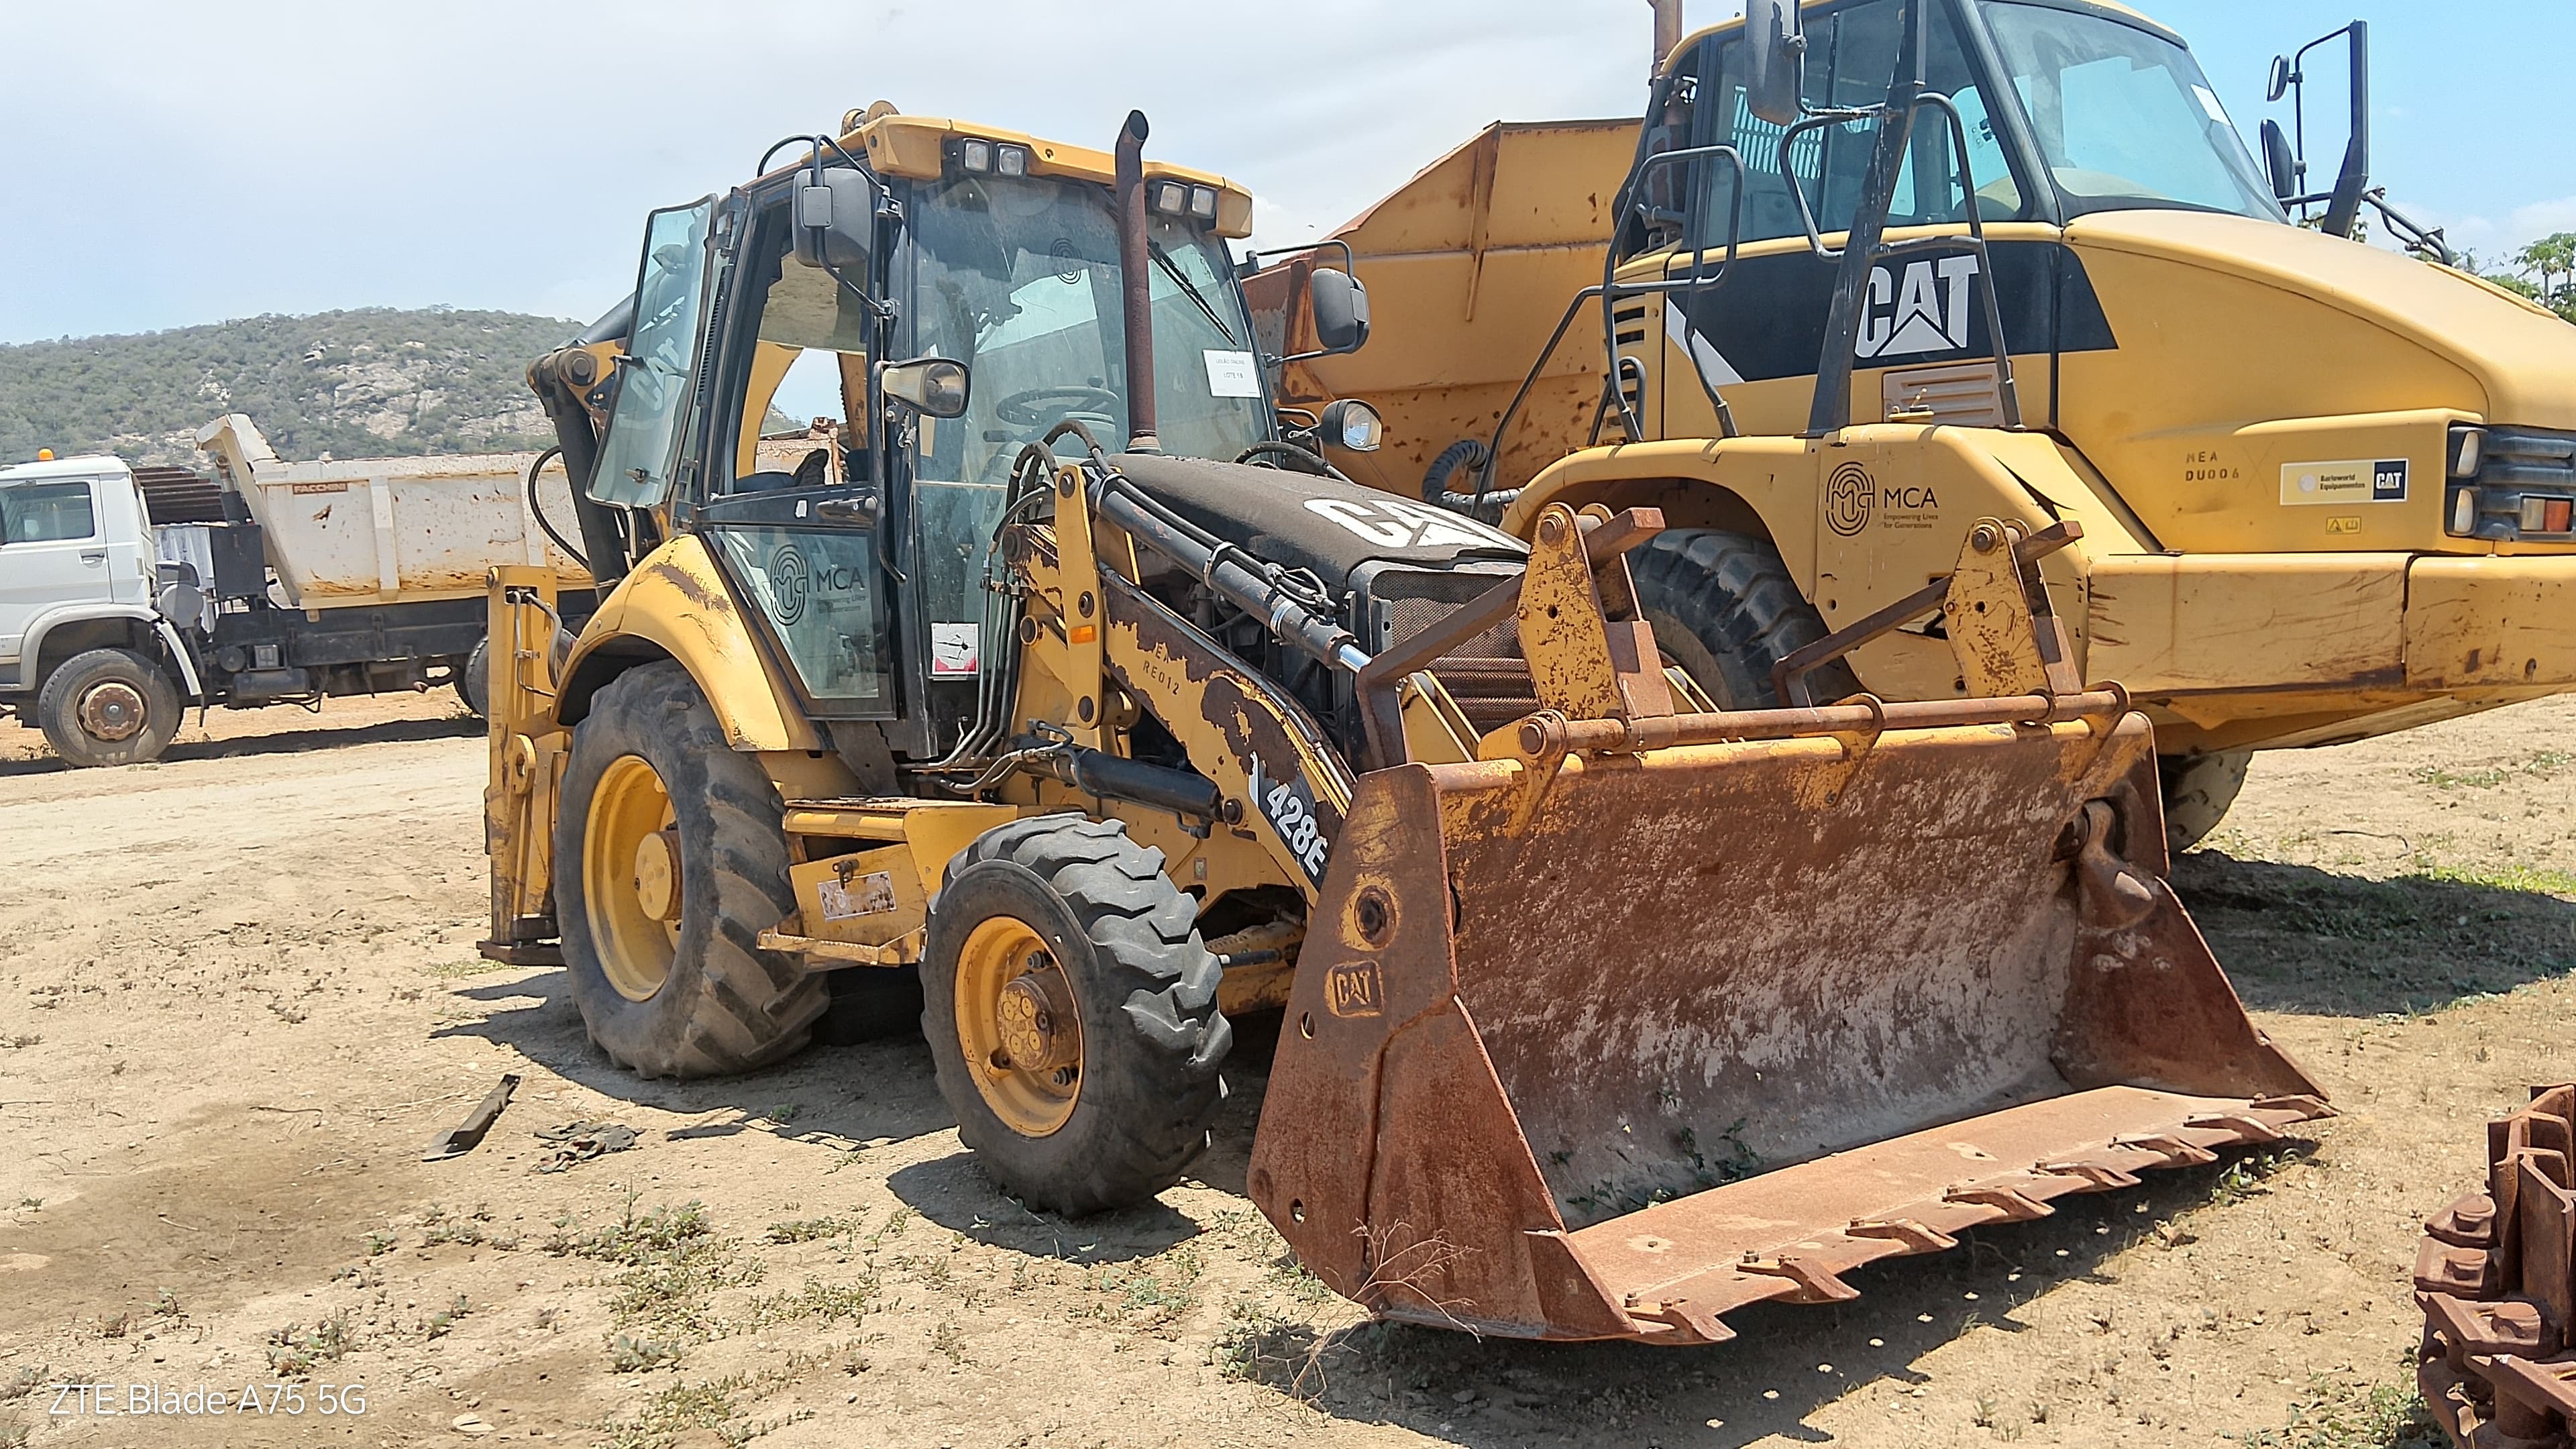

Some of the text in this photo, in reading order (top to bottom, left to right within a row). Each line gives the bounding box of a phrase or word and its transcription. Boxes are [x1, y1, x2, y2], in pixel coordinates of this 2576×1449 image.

[1854, 254, 1979, 358] CAT
[2186, 468, 2239, 481] DU006
[2375, 472, 2402, 490] CAT
[1884, 487, 1938, 508] MCA
[1303, 498, 1531, 555] CAT
[1884, 513, 1921, 521] Empowering
[816, 568, 865, 592] MCA
[1143, 660, 1179, 695] RE012
[1267, 782, 1328, 877] 428E
[1336, 970, 1371, 1007] CAT
